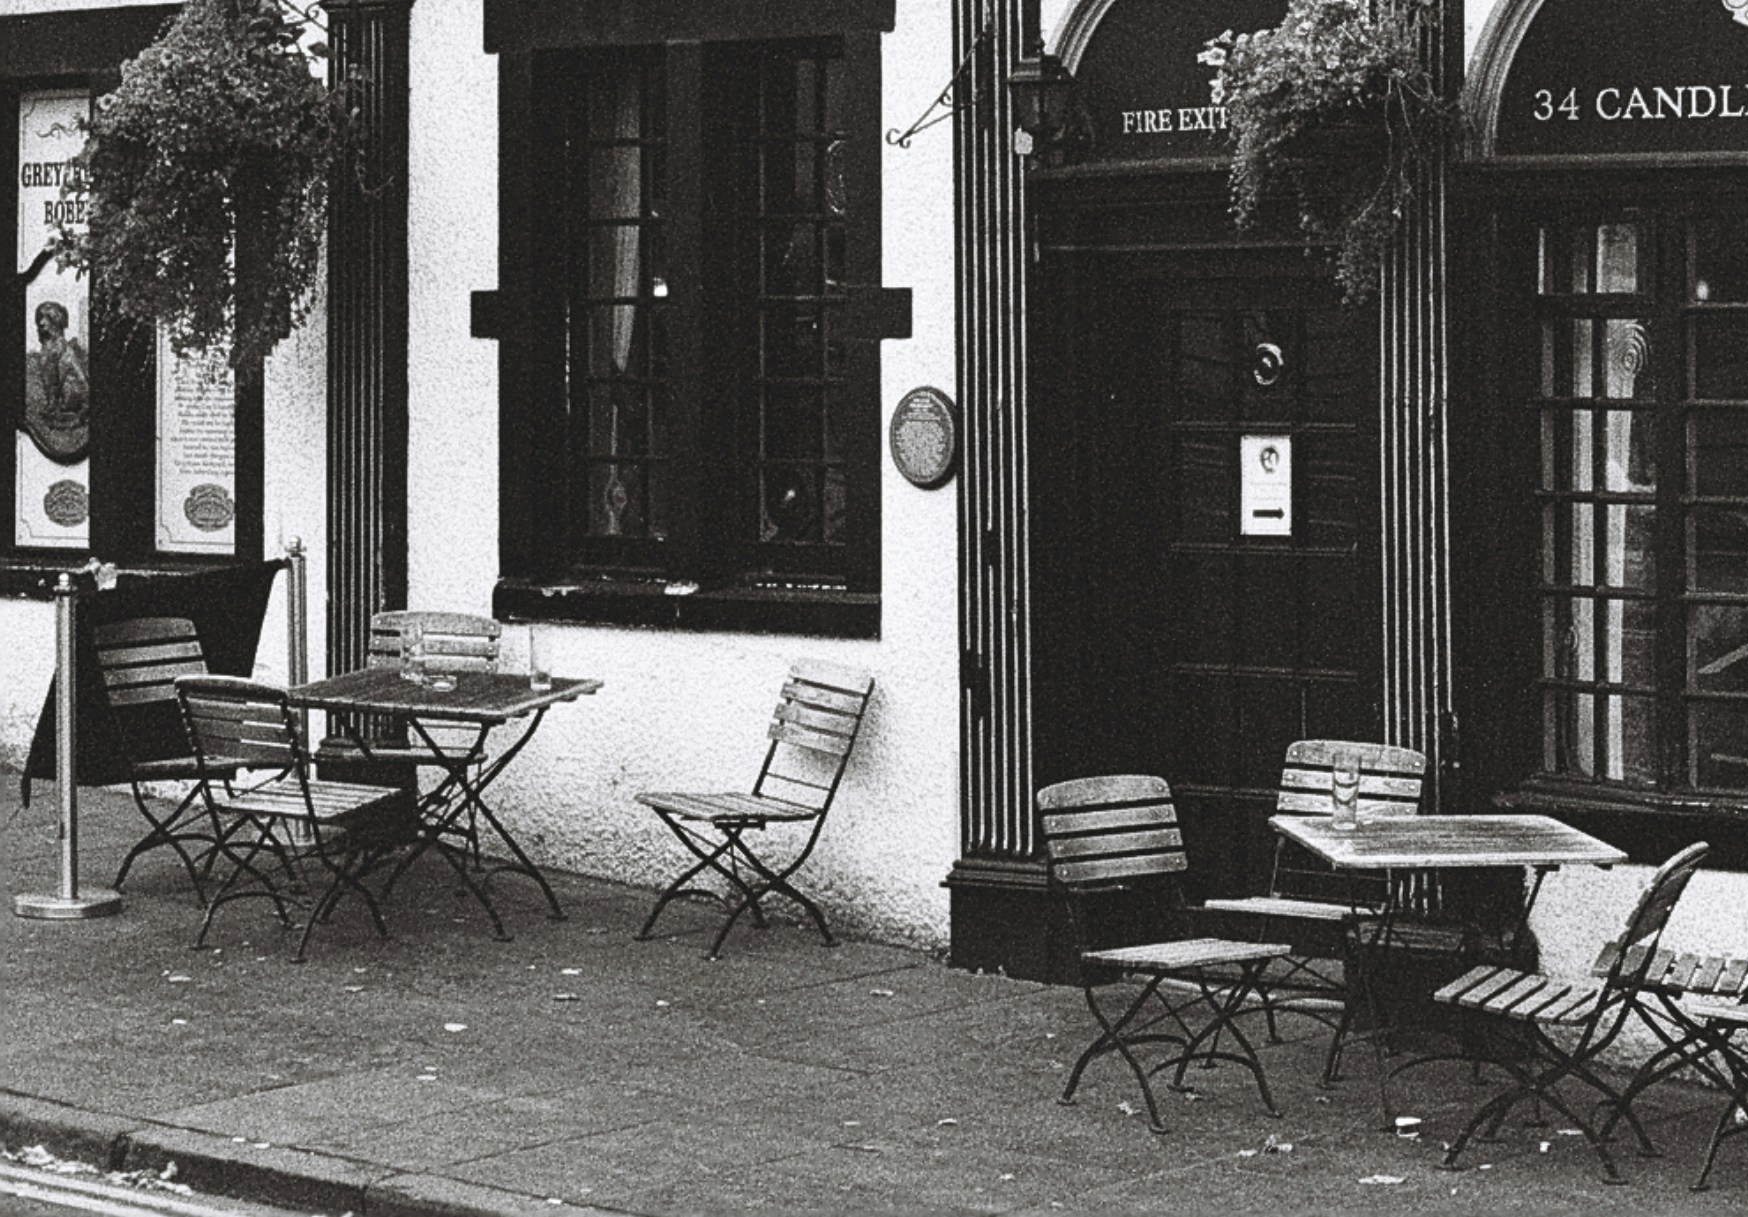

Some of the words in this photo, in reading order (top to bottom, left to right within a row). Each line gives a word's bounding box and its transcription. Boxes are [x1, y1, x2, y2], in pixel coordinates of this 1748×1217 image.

[1534, 88, 1579, 121] 34
[1122, 109, 1173, 133] FIRE
[1178, 106, 1227, 132] EXIT
[44, 200, 91, 224] BOBB
